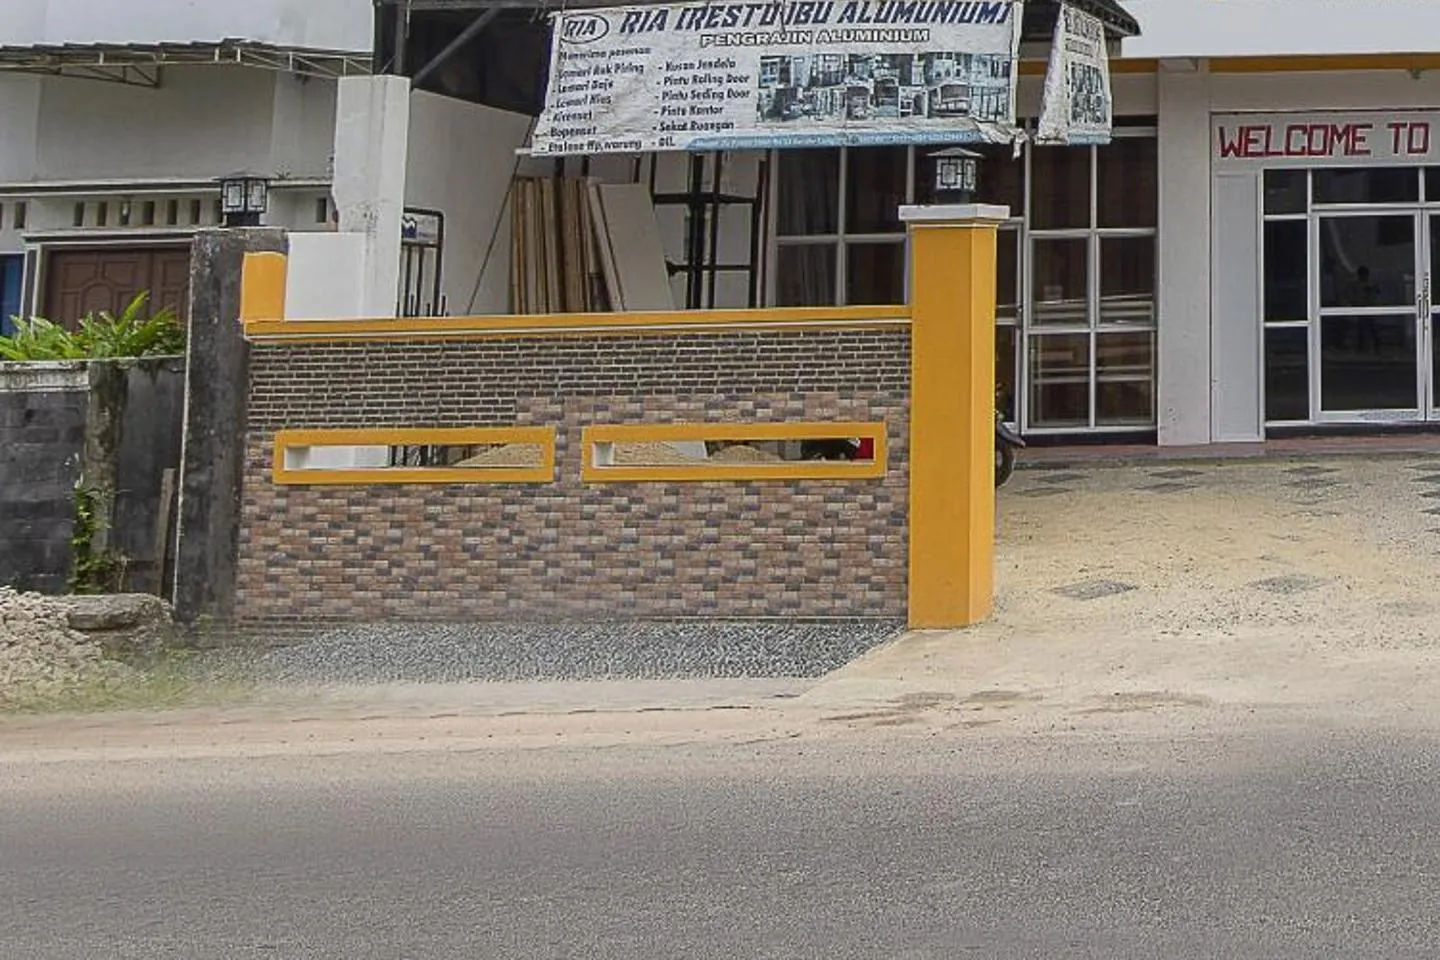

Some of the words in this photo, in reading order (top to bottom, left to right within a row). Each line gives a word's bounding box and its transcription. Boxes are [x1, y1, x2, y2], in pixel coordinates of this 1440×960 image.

[564, 18, 598, 38] RIA
[619, 8, 670, 35] RIA
[701, 29, 813, 48] PENGRAJIN
[815, 28, 931, 44] ALUMINIUM
[725, 74, 751, 84] Door
[727, 88, 751, 99] Door
[1218, 122, 1373, 158] WELCOME
[1387, 121, 1430, 155] TO
